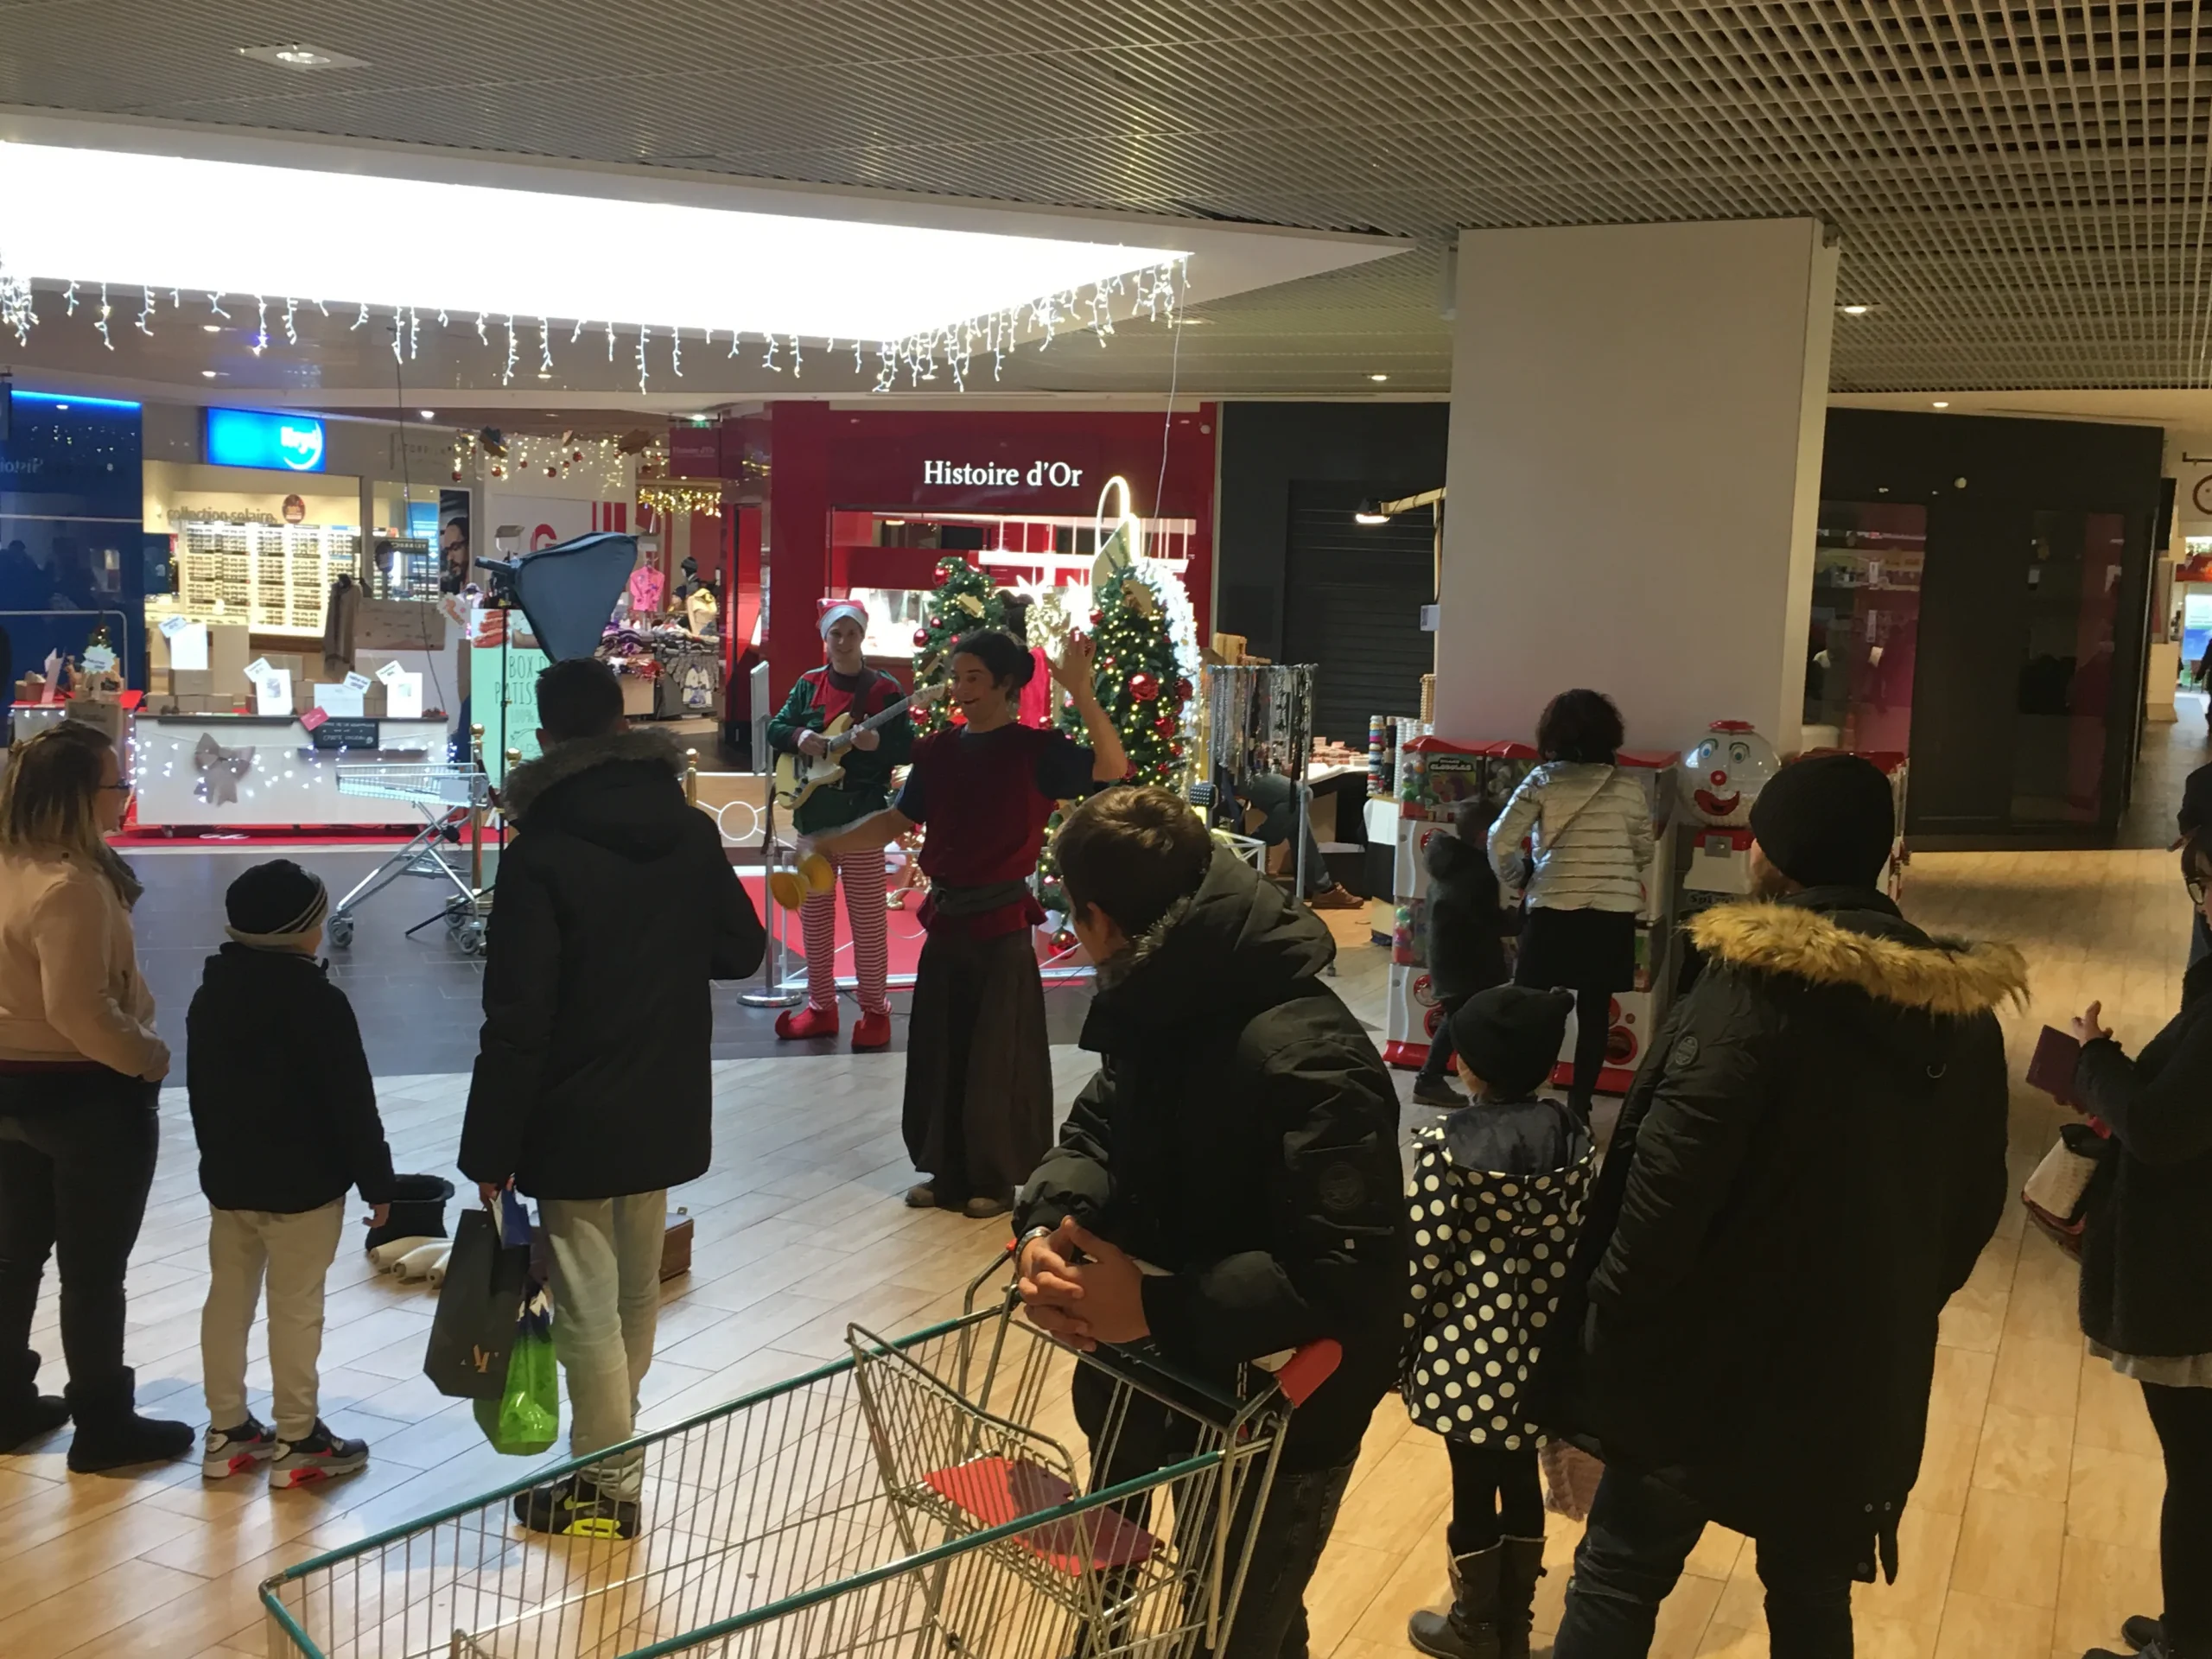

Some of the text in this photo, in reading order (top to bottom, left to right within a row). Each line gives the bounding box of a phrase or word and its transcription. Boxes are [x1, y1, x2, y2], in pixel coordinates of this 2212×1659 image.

[924, 460, 1084, 487] Histoire d'Or
[509, 656, 533, 678] BOX
